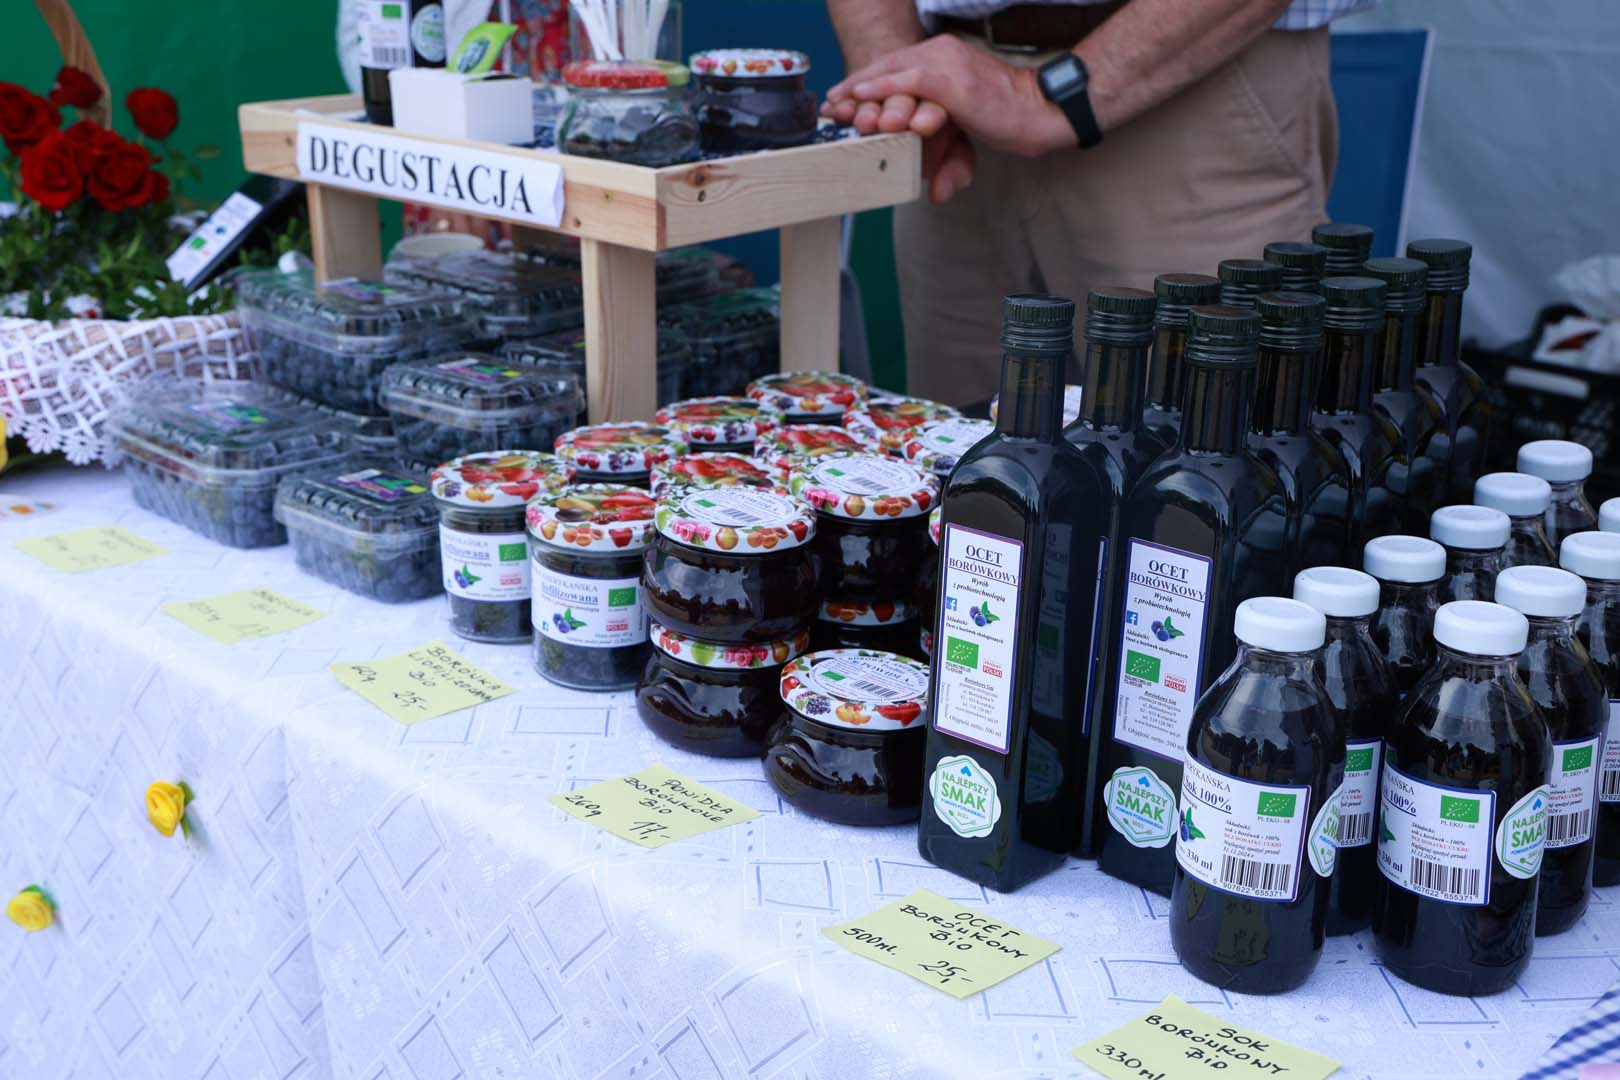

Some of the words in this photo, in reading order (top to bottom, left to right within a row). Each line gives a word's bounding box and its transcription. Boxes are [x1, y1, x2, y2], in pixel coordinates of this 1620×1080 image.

[310, 135, 533, 214] DEGUSTACJA
[966, 544, 1003, 564] OCET
[949, 557, 1018, 584] BORÓWKOWY
[1149, 559, 1189, 580] OCET
[1130, 571, 1206, 601] BORÓWKOWY
[1154, 591, 1173, 603] Wyrób
[1137, 598, 1192, 619] probiotechnologią
[1165, 680, 1186, 693] POLSKI
[942, 770, 989, 796] NAJLEPSZY
[1118, 779, 1168, 808] NAJLEPSZY
[1185, 776, 1198, 795] Sok
[1199, 787, 1232, 811] 100%
[564, 794, 603, 818] 260g
[941, 782, 986, 813] SMAK
[1116, 790, 1165, 824] SMAK
[1390, 789, 1416, 814] 100%
[1186, 848, 1199, 863] 330
[1201, 859, 1213, 871] ml
[1392, 861, 1403, 873] ml
[1222, 880, 1250, 894] 907622
[1254, 887, 1283, 897] 655371
[1413, 882, 1440, 898] 907622
[1444, 892, 1473, 902] 655371
[899, 904, 1029, 959] BORÓWKOWY
[954, 912, 1020, 938] OCET
[1216, 1027, 1270, 1052] SOK
